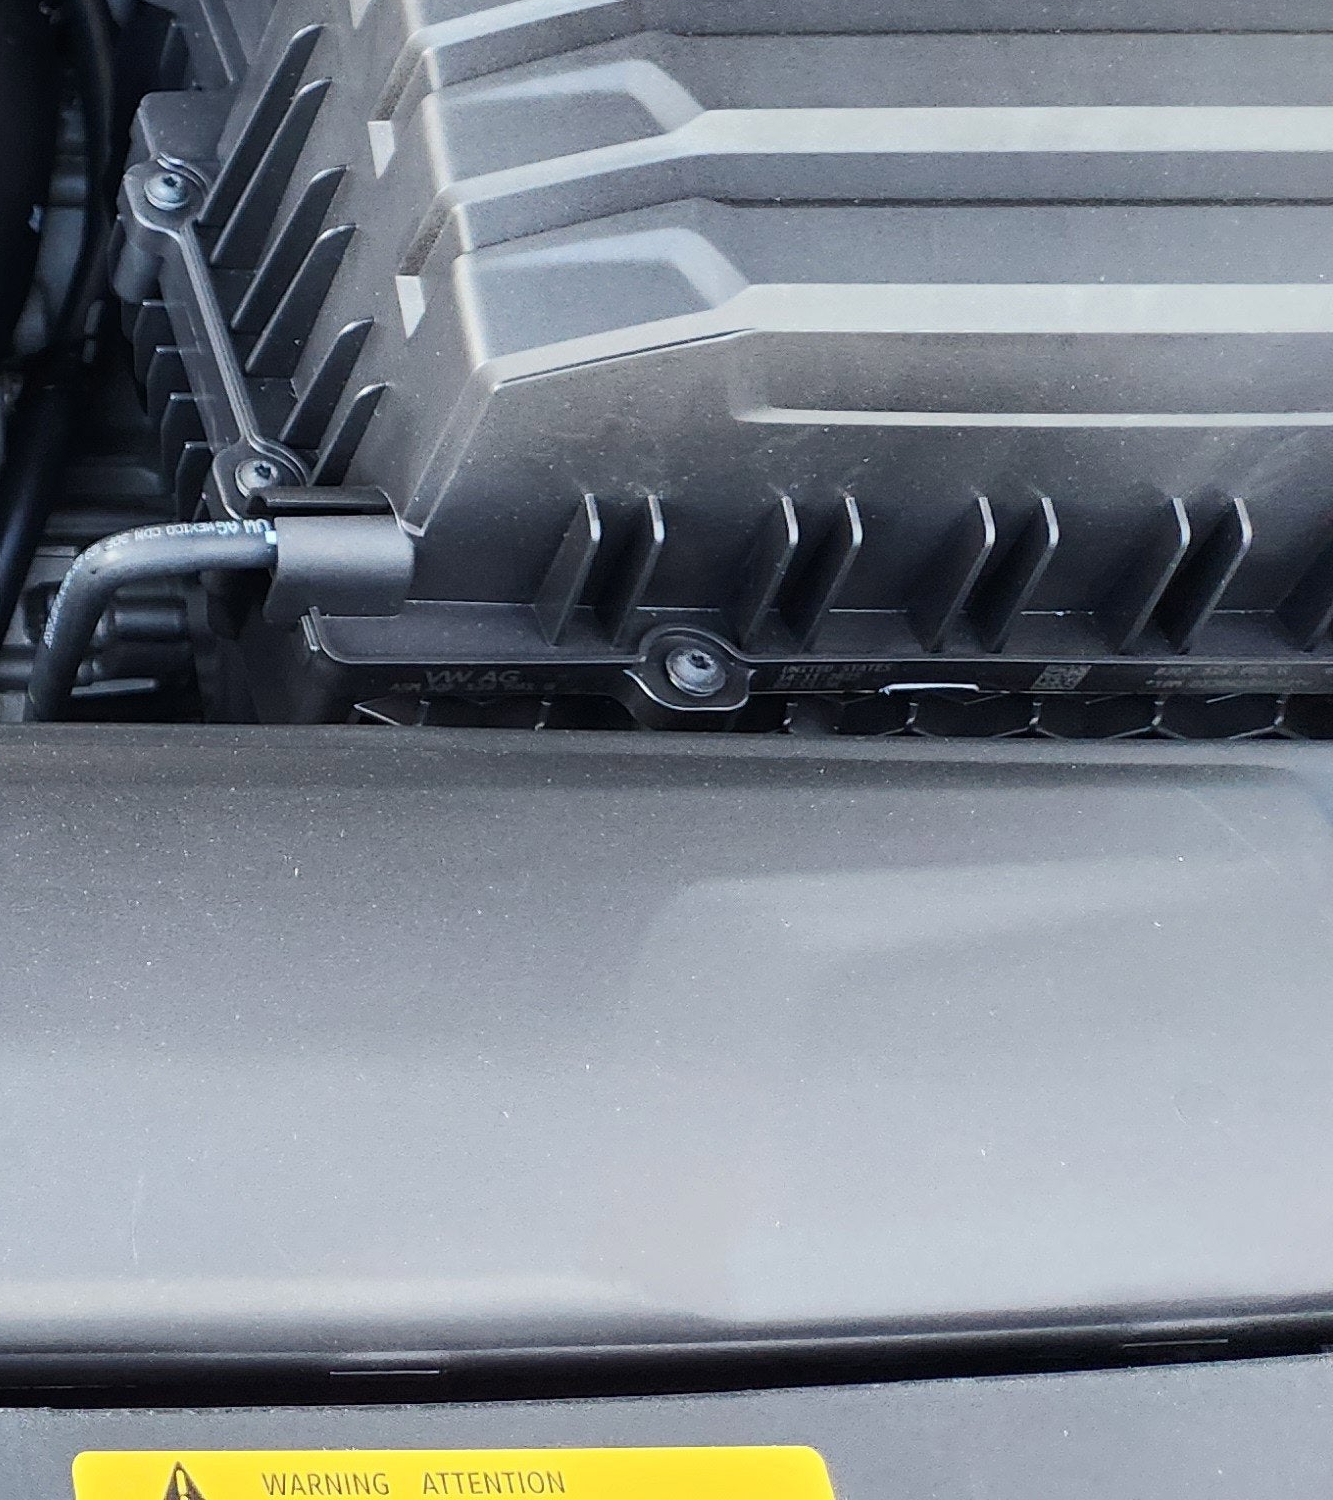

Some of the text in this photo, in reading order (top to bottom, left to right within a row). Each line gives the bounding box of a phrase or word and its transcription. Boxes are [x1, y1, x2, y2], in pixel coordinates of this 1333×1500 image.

[166, 521, 216, 536] MEXICO
[425, 669, 521, 683] VW AG
[261, 1470, 567, 1496] WARNING ATTENTION
